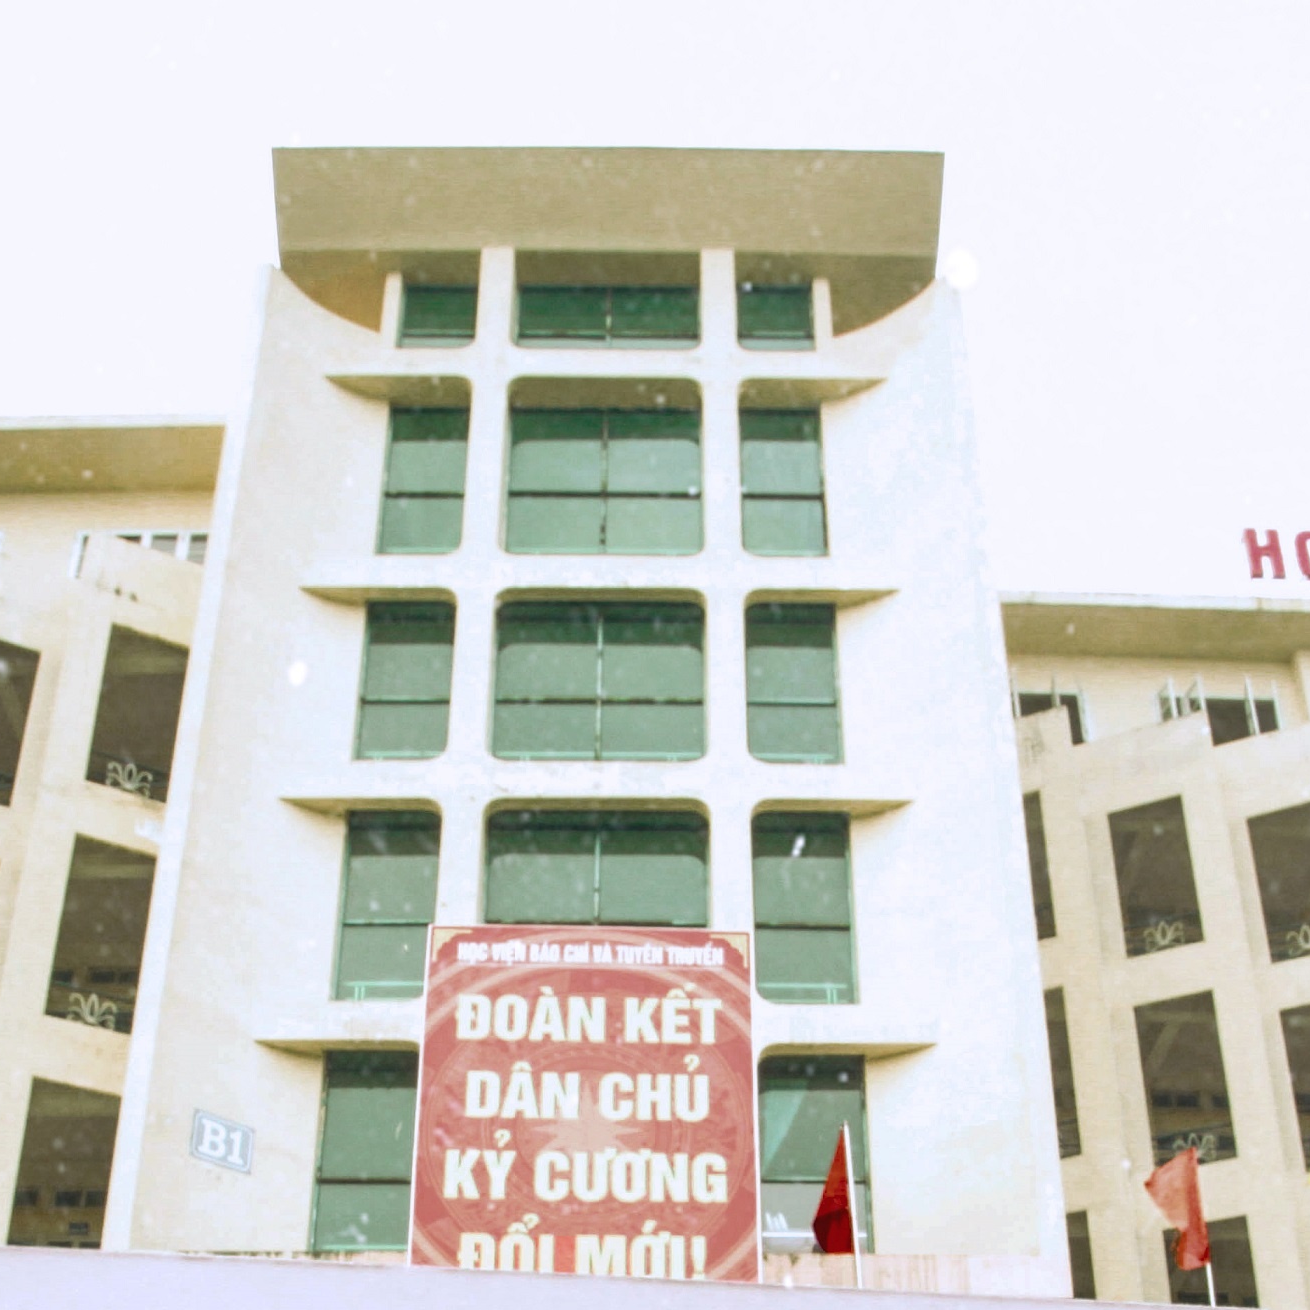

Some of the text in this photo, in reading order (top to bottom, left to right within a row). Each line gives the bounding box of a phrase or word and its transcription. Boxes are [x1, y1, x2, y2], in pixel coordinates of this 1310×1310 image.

[455, 982, 723, 1044] ĐOÀN KẾT
[464, 1054, 710, 1122] DÂN CHỦ
[197, 1117, 246, 1168] B1
[443, 1128, 729, 1203] KỶ CƯƠNG
[458, 1213, 707, 1280] ĐỔI MỚI!
